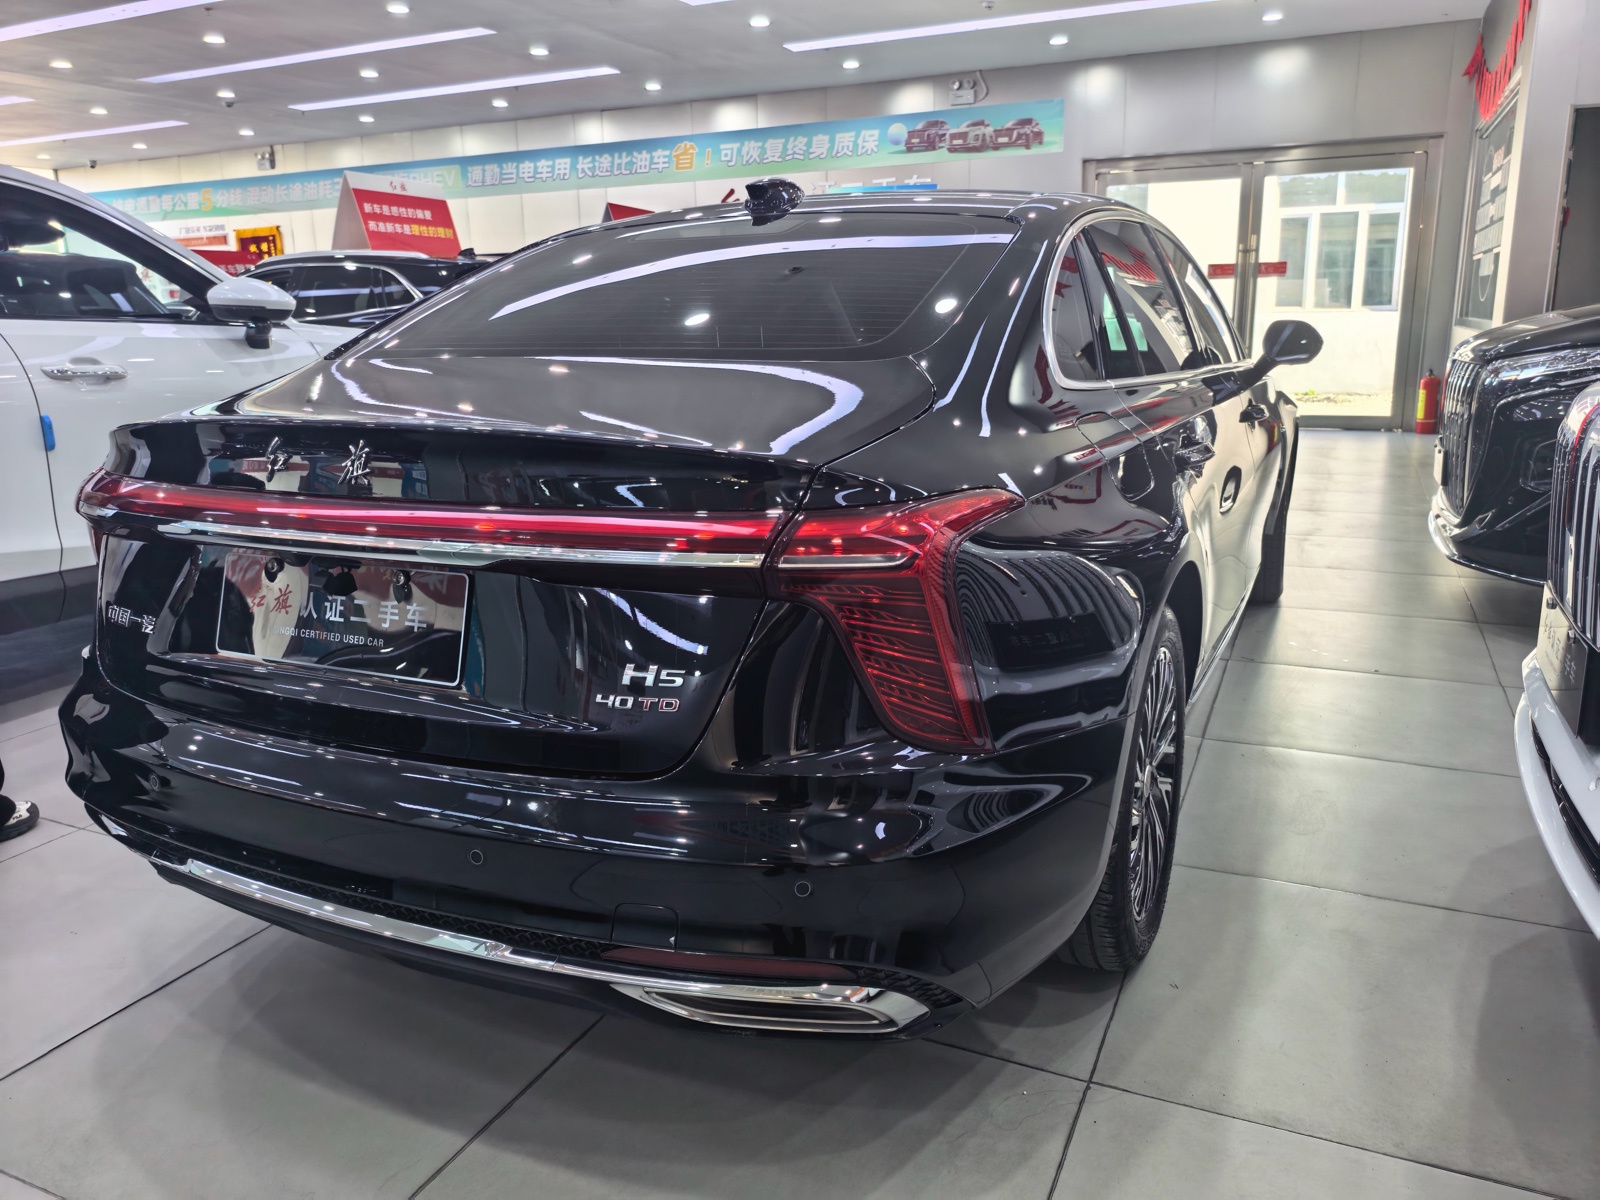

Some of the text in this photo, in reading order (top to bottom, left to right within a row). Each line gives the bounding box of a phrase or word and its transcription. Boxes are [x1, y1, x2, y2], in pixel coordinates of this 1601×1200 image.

[466, 158, 571, 187] 通勤当电车用
[719, 129, 881, 167] 可恢复终身质保
[265, 436, 371, 486] 红旗
[300, 591, 427, 633] 认证二手车
[300, 627, 341, 642] CERTIFIED
[343, 634, 365, 645] USED
[367, 637, 384, 648] CAR
[621, 663, 686, 687] H5
